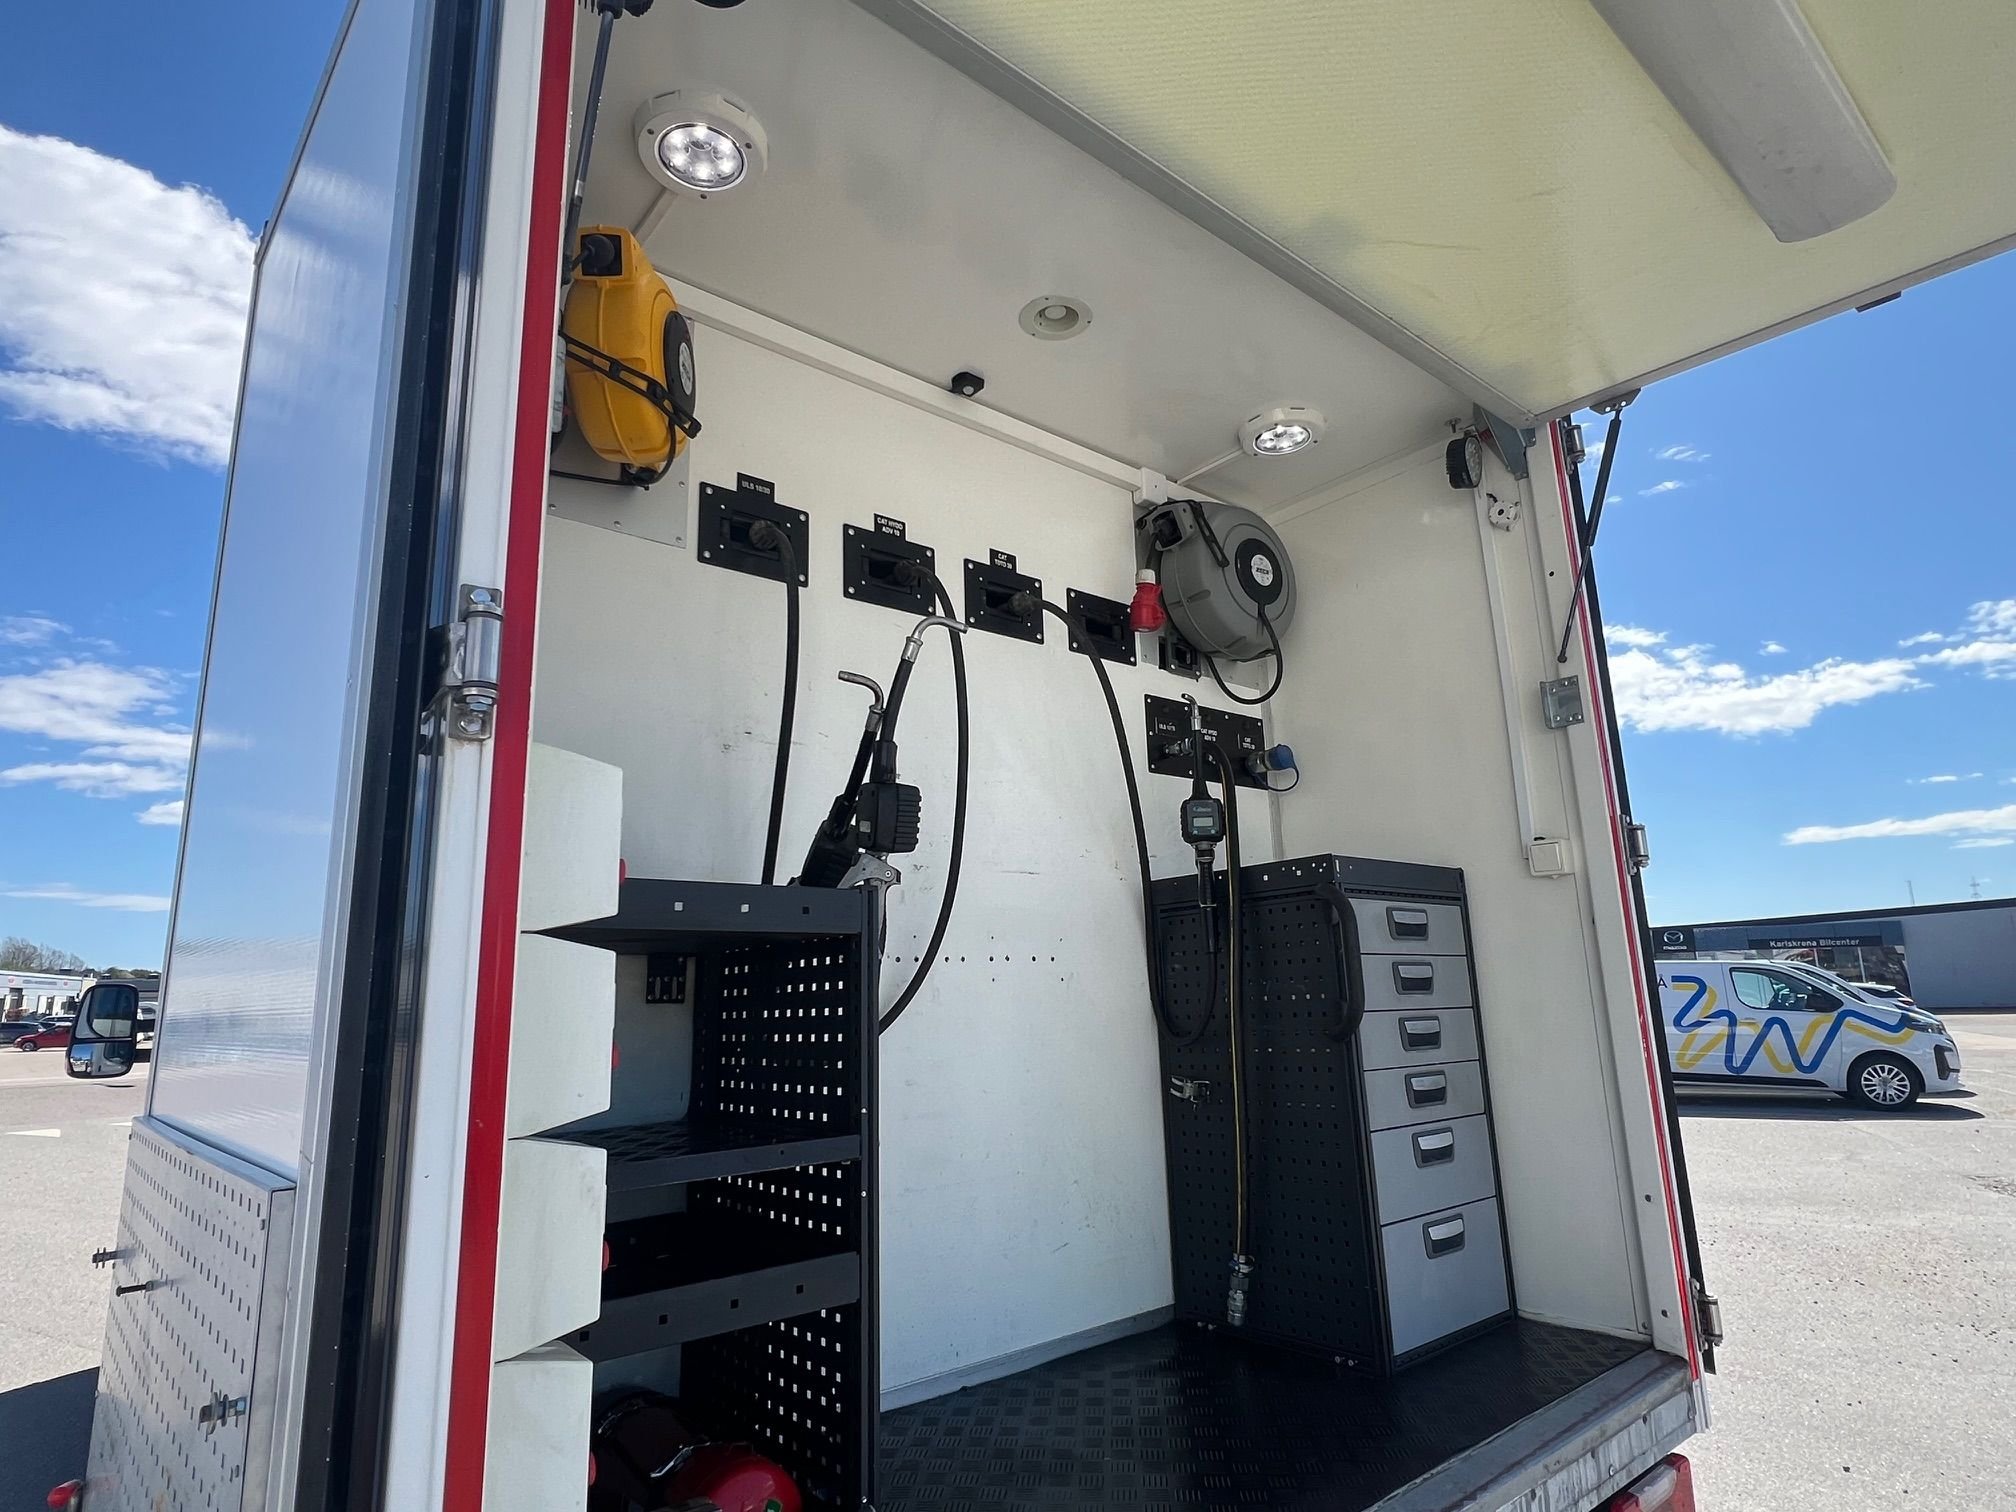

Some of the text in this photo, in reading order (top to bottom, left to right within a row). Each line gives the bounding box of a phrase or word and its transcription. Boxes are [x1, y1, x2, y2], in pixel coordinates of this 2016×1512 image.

[877, 517, 888, 525] CAT
[998, 553, 1007, 561] CAT
[1819, 938, 1860, 946] Bilcenter
